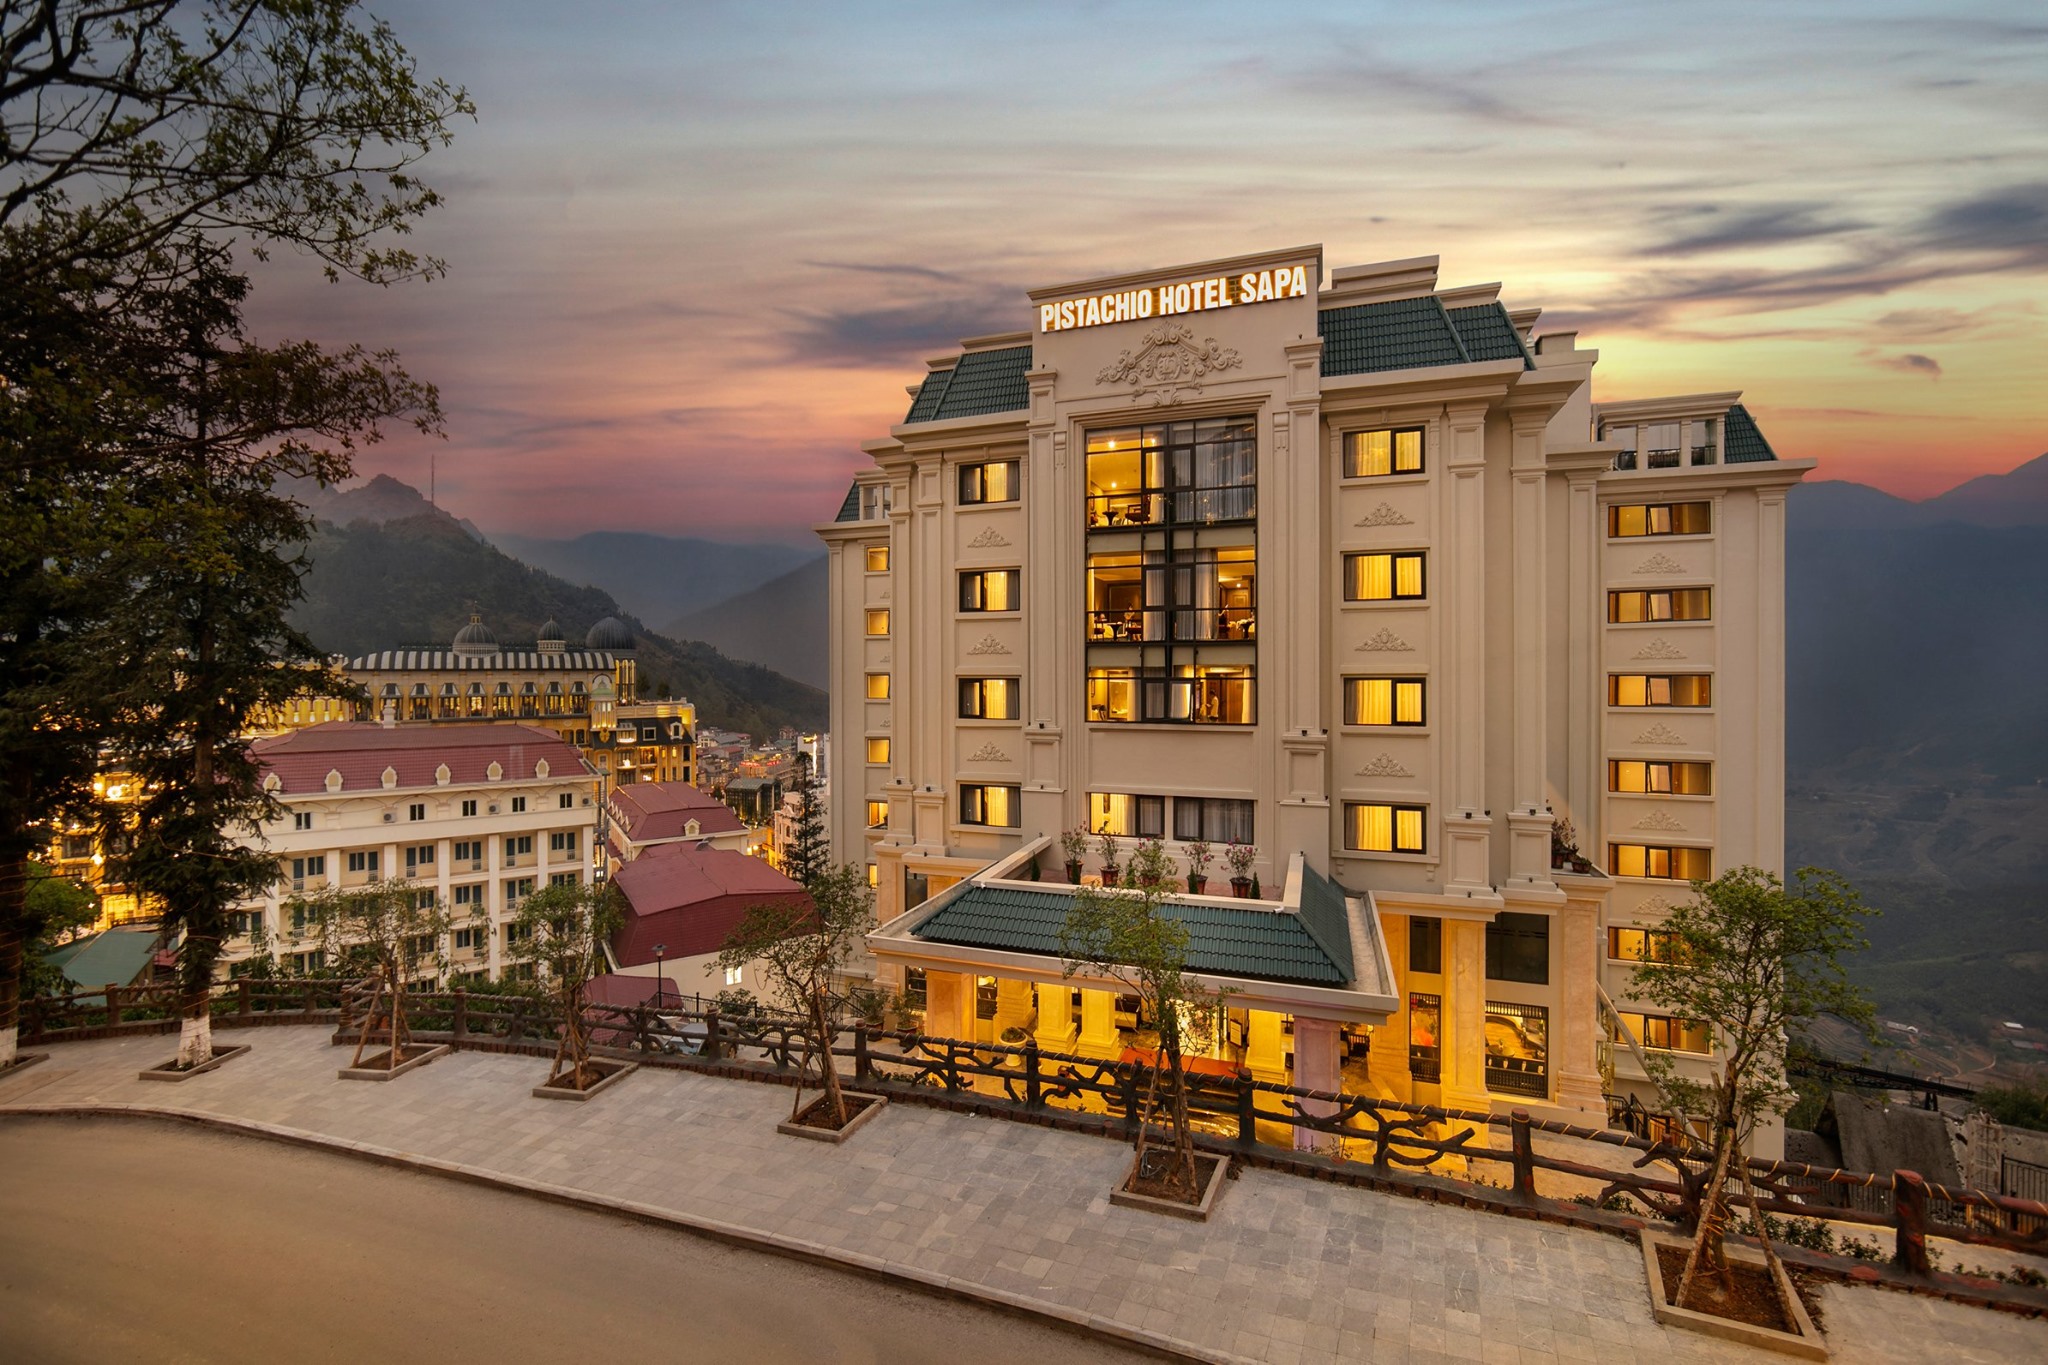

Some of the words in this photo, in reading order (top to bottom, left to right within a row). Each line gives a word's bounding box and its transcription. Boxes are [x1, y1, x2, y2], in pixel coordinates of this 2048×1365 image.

[1041, 289, 1152, 332] PISTACHIO
[1159, 277, 1232, 315] HOTEL
[1240, 265, 1307, 303] SAPA
